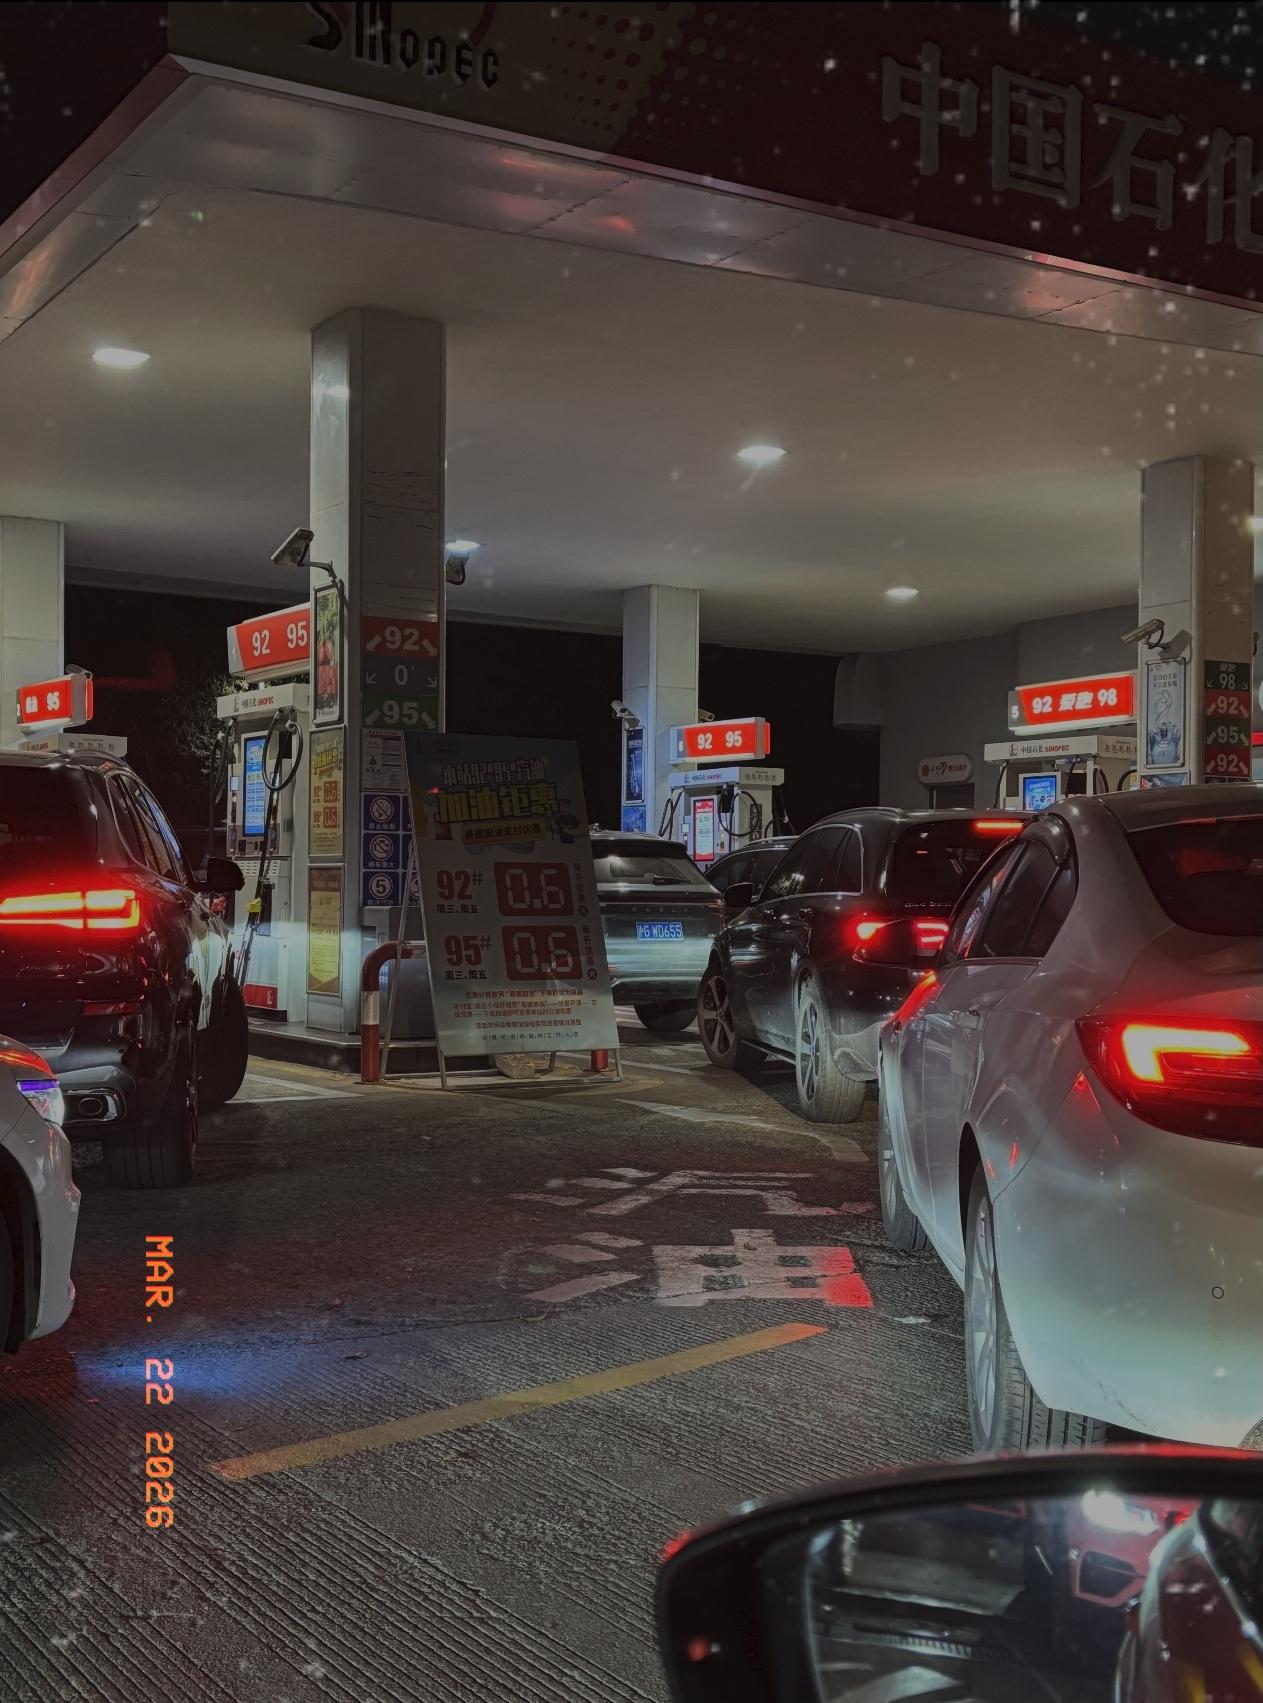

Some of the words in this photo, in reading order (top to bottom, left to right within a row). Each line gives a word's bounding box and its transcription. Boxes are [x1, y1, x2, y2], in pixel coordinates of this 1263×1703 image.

[880, 40, 1263, 254] 中国石化
[252, 628, 271, 657] 92
[287, 621, 307, 649] 95
[384, 626, 420, 652] 92
[1219, 673, 1237, 690] 98
[382, 700, 419, 725] 95
[1012, 705, 1020, 719] 5
[1032, 695, 1053, 714] 92
[1098, 688, 1118, 707] 98
[1216, 695, 1239, 714] 92
[697, 732, 713, 750] 92
[725, 730, 743, 749] 95
[1216, 725, 1239, 744] 95
[1045, 744, 1070, 754] SINOPEC
[1216, 754, 1239, 774] 92
[437, 783, 559, 824] 加油钜惠
[375, 879, 387, 894] 5
[437, 869, 484, 901] 92#
[505, 868, 565, 910] 0.6
[437, 904, 479, 914] 周三、周五
[444, 934, 491, 966] 95#
[513, 931, 573, 973] 0.6
[445, 970, 488, 980] 周三、周五
